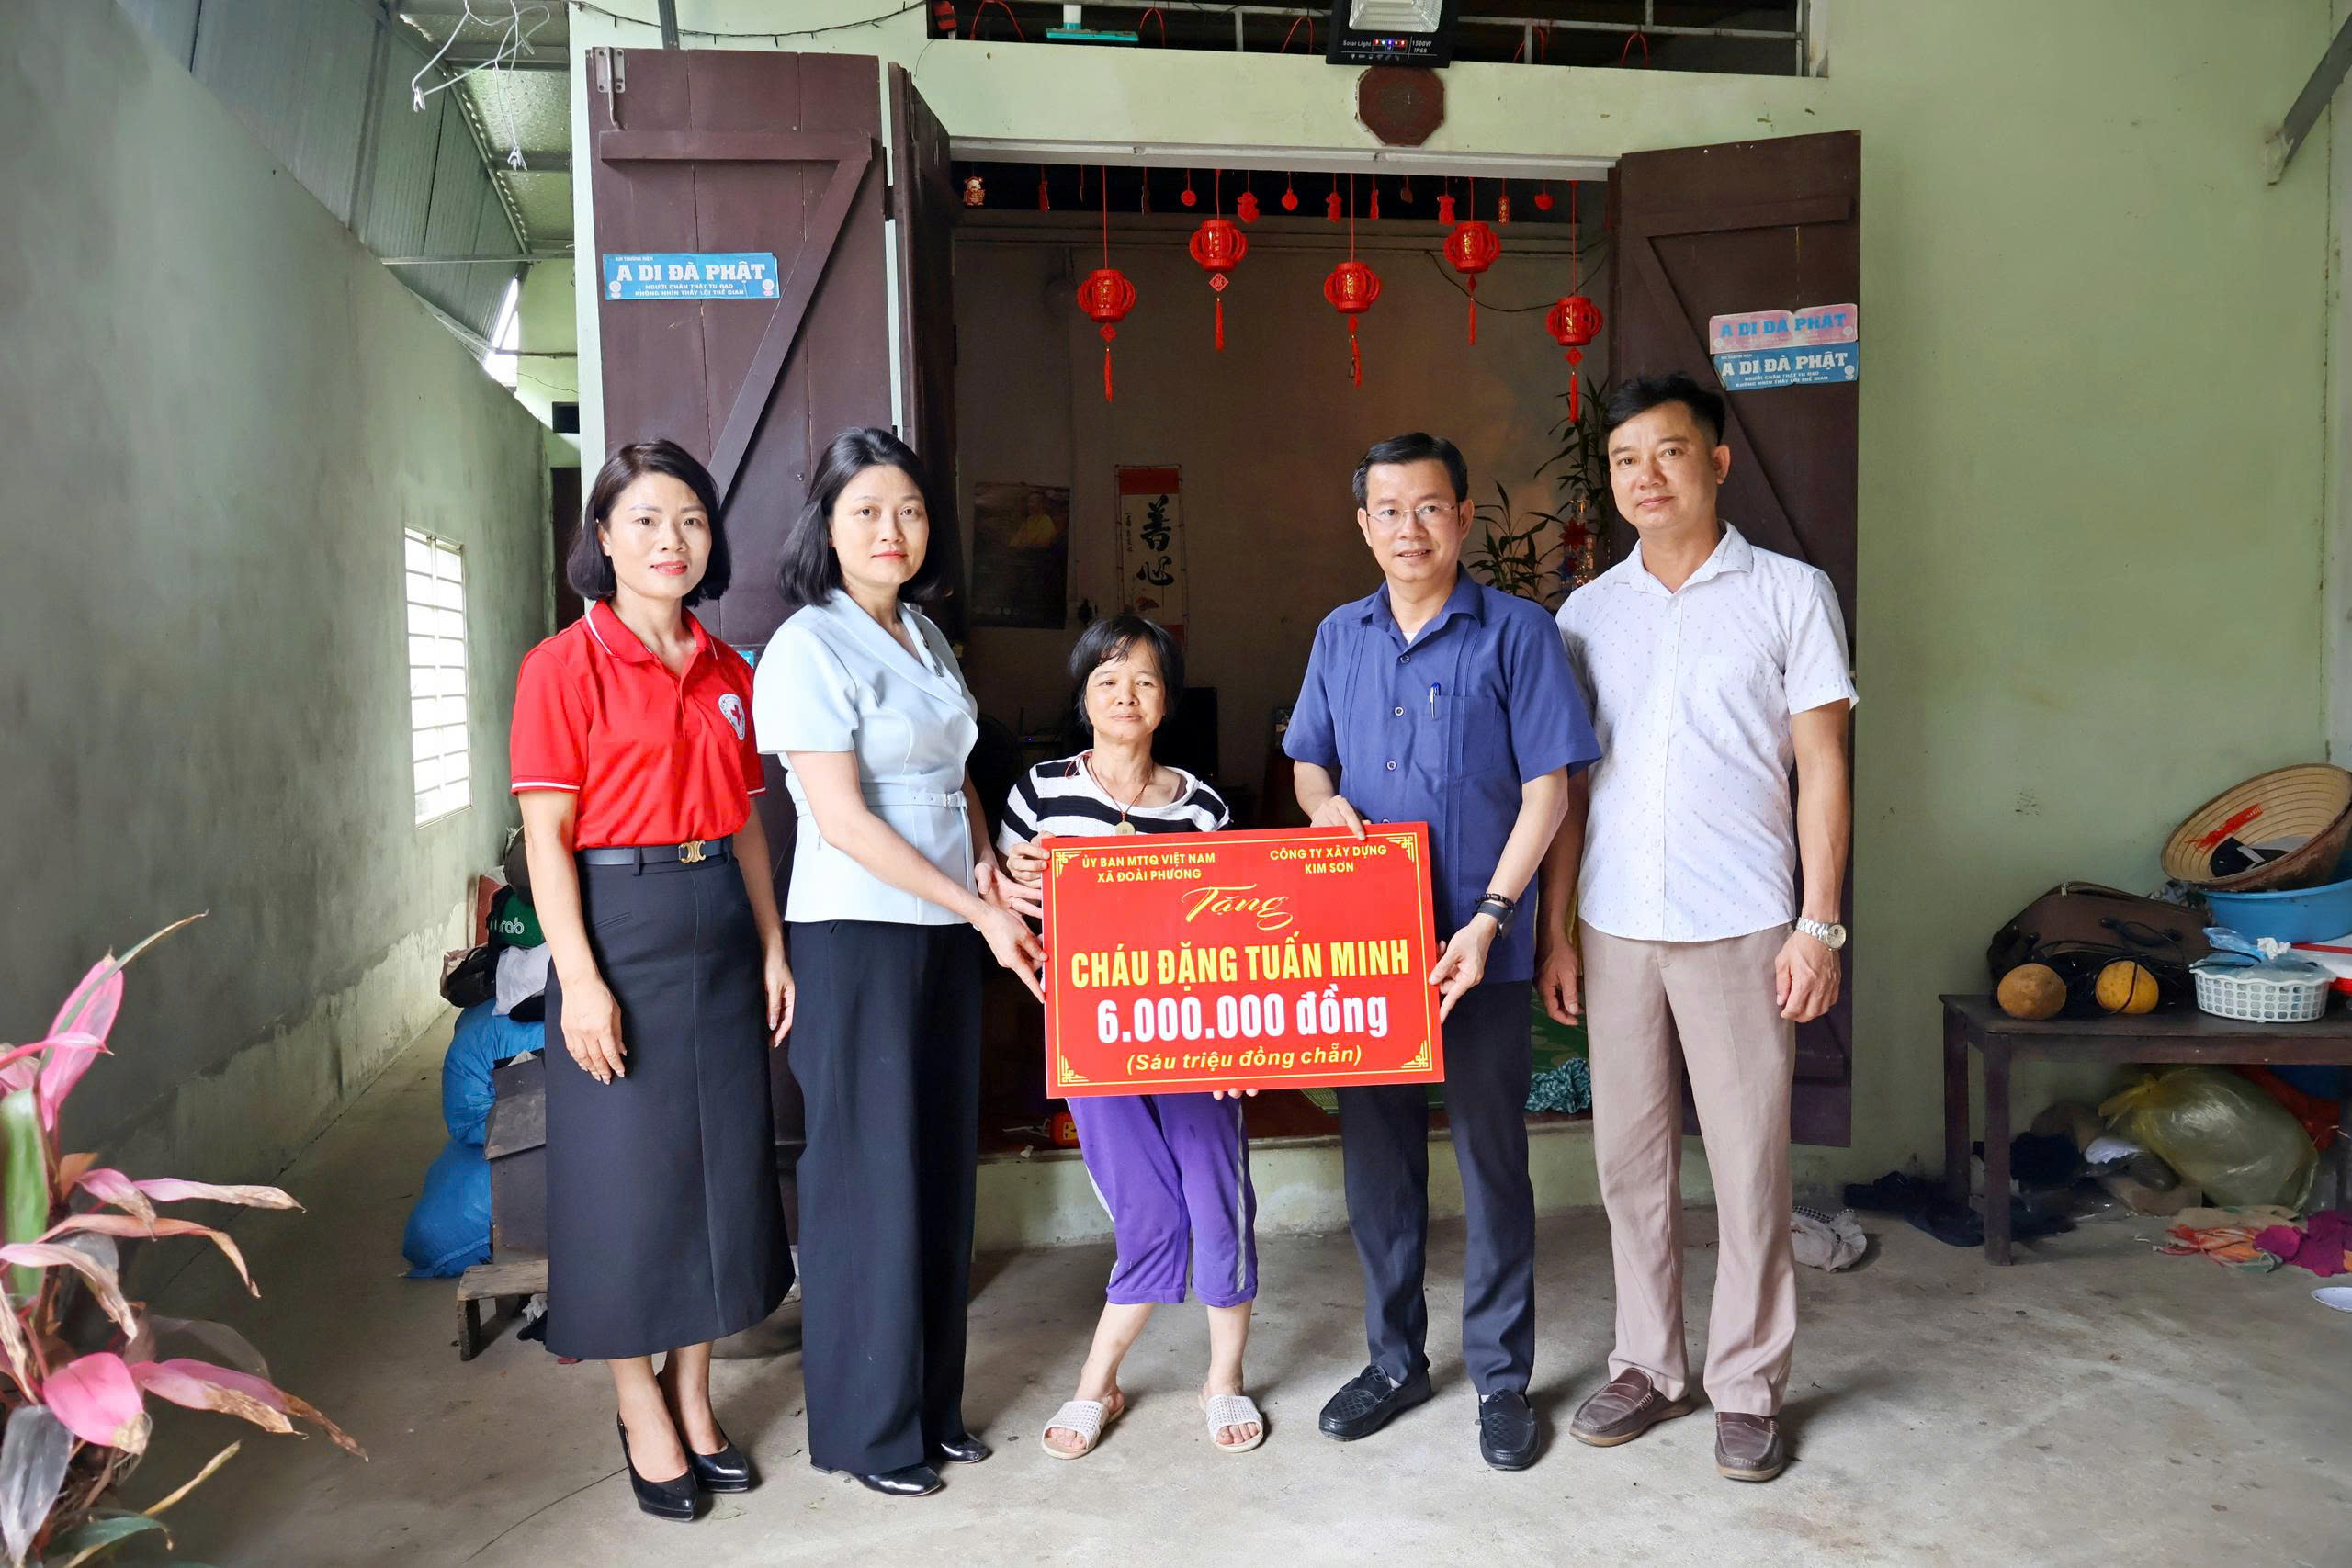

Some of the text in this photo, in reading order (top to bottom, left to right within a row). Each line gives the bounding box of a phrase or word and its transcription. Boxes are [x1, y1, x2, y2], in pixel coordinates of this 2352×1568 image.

[616, 260, 765, 284] A DI ĐÀ PHẬT
[1720, 323, 1733, 338] A
[1738, 321, 1758, 336] DI
[1722, 362, 1735, 376] A
[1739, 359, 1760, 375] DI
[1764, 355, 1791, 372] ĐÀ
[1795, 351, 1848, 370] PHẬT
[1082, 852, 1216, 868] ỦY BAN MTTQ VIỆT NAM
[1270, 844, 1387, 861] CÔNG TY XÂY DỰNG
[1097, 868, 1202, 883] XÃ ĐOÀI PHƯƠNG
[1305, 861, 1354, 874] KIM SƠN
[1181, 883, 1294, 931] Tặng
[490, 917, 525, 935] rab
[1071, 931, 1410, 992] CHÁU ĐẶNG TUẤN MINH
[1097, 984, 1388, 1043] 6.000.000 đồng
[1126, 1043, 1363, 1075] (Sáu triệu đồng chẵn)
